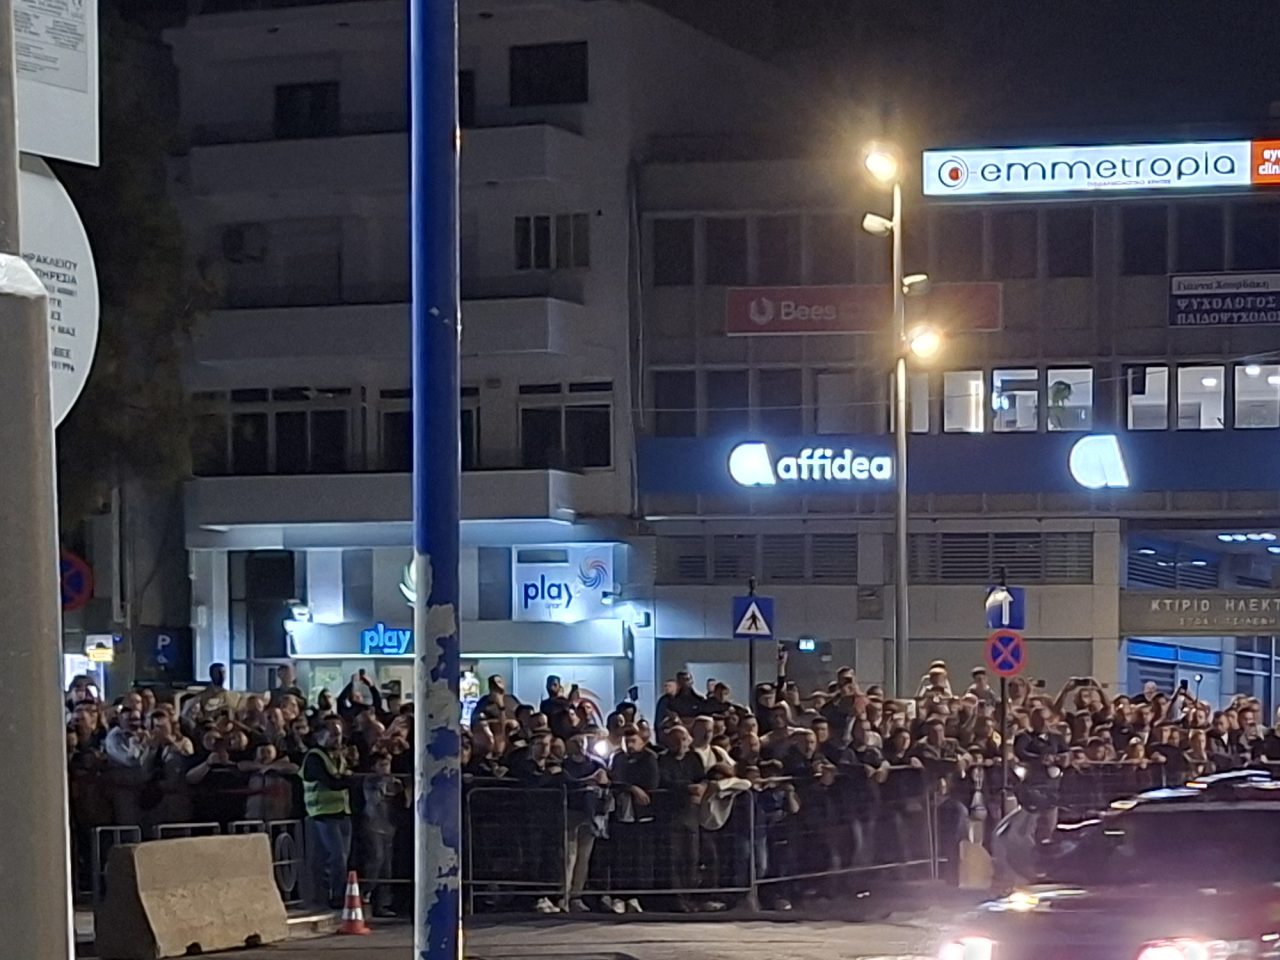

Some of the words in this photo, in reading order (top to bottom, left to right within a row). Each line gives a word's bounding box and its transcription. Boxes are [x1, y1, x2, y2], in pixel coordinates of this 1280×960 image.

[1177, 296, 1276, 310] ΨΥΧΟΛΟΓΟΣ
[776, 448, 893, 481] affidea
[523, 574, 573, 608] play
[1151, 599, 1210, 612] ΚΤΙΡΙΟ
[157, 634, 171, 650] P
[364, 623, 411, 654] play
